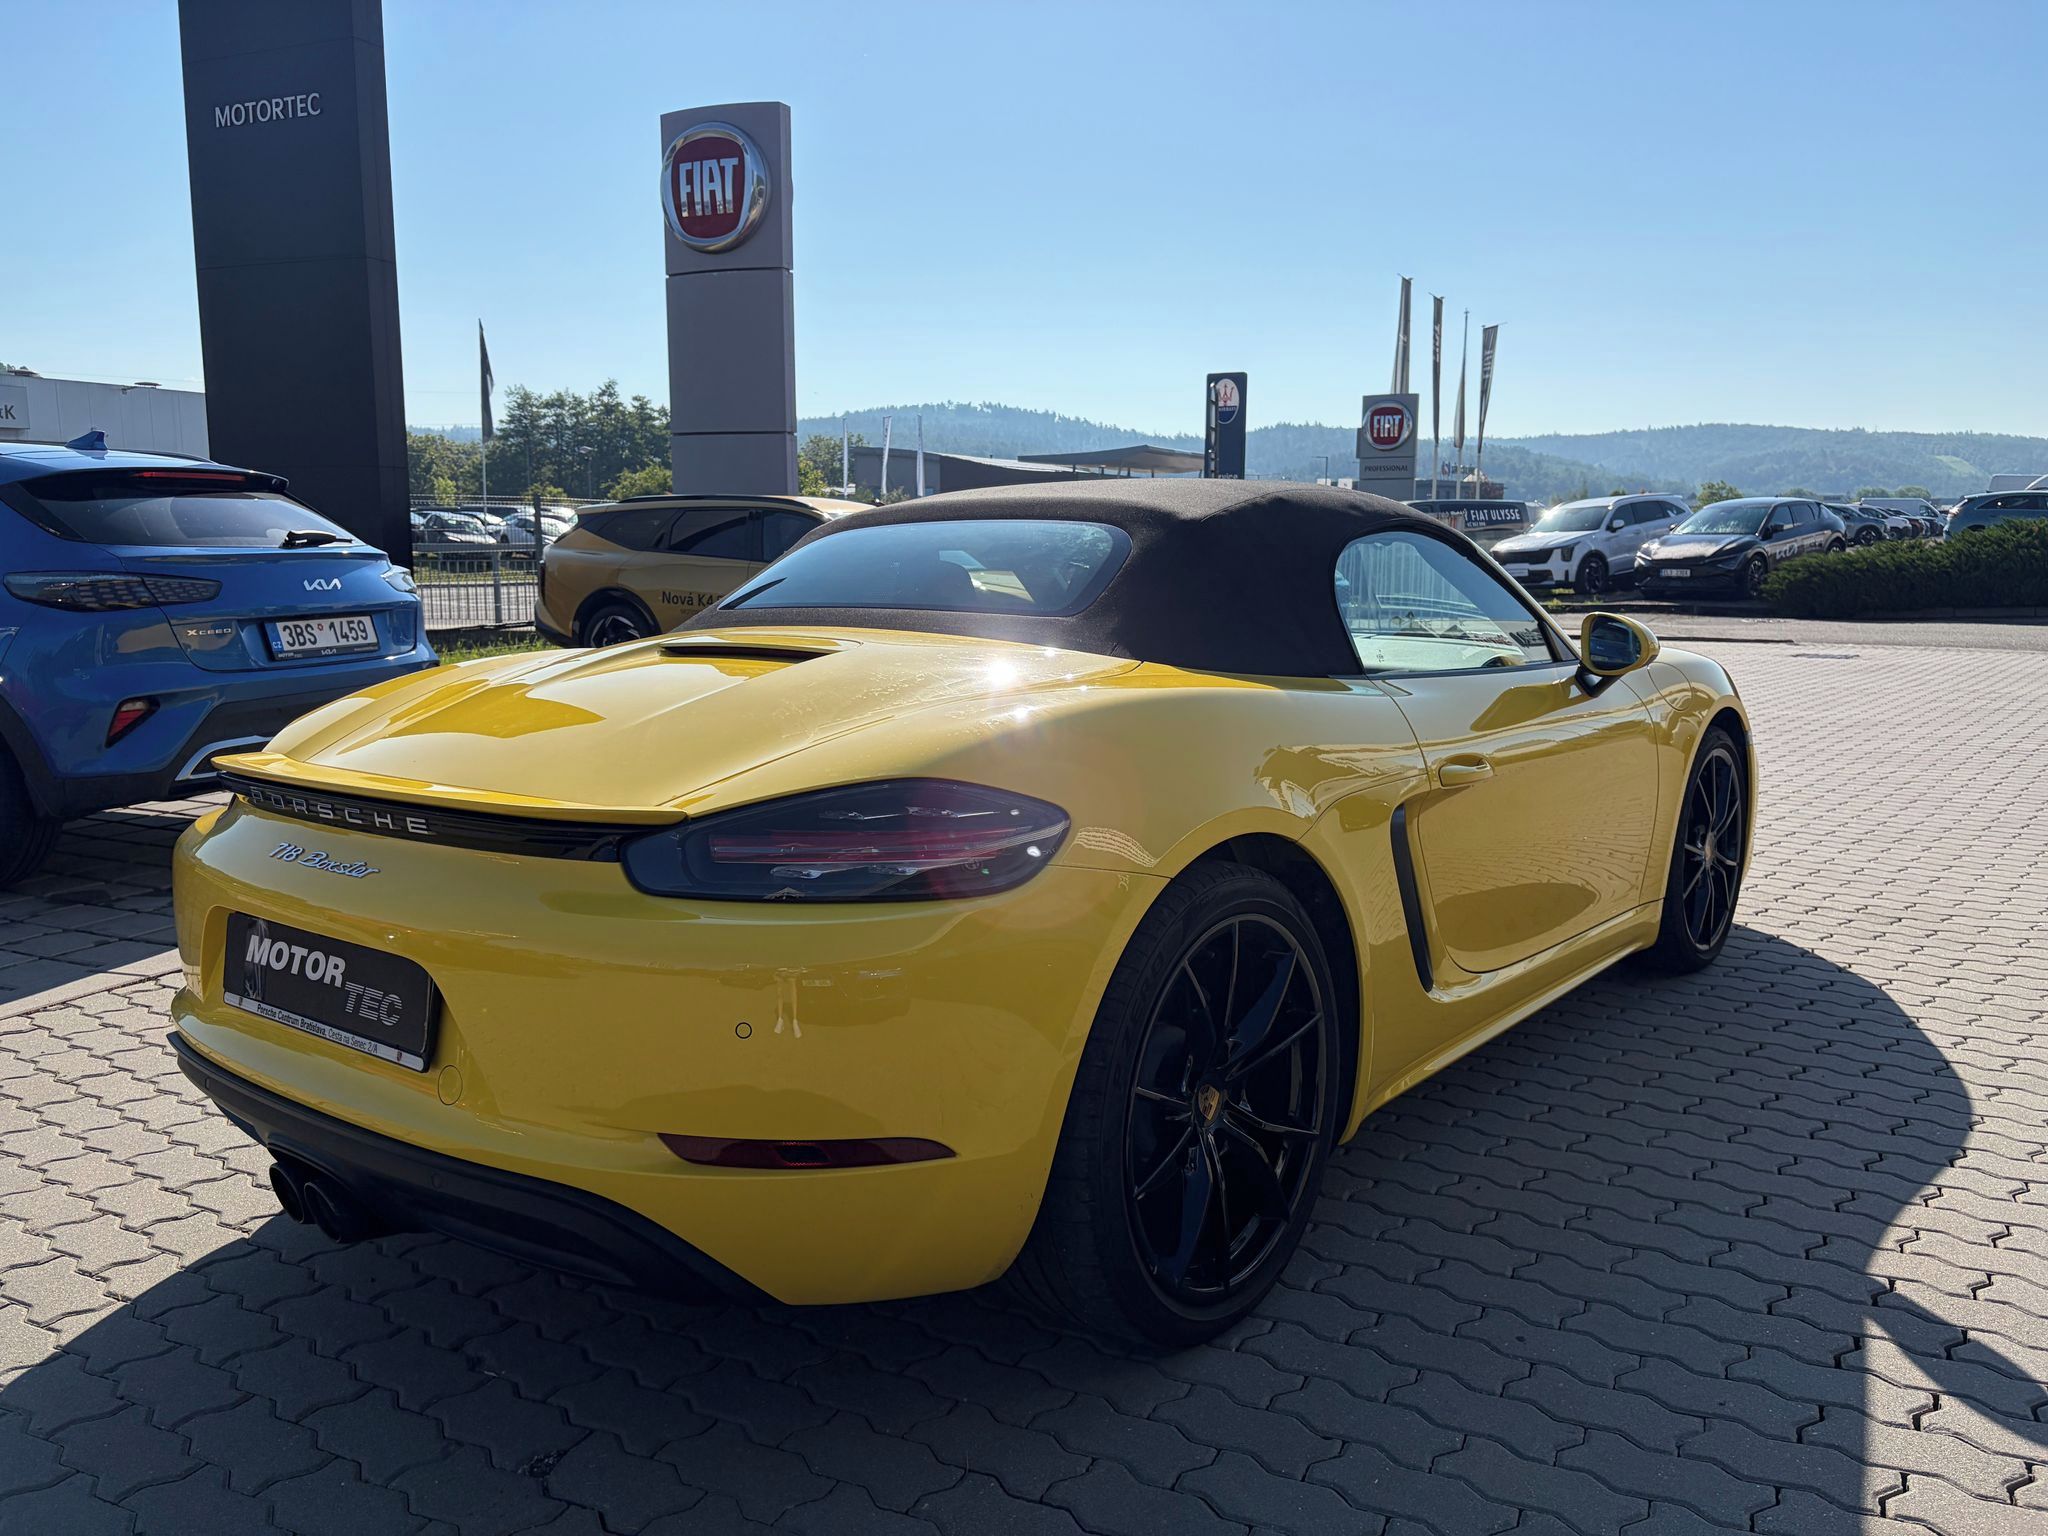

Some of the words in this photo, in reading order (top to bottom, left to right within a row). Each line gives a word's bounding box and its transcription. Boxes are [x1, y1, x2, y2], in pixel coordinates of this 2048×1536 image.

[214, 92, 321, 128] MOTORTEC
[679, 157, 739, 218] FIAT
[1373, 414, 1402, 438] FIAT
[1364, 464, 1408, 472] PROFESSIONAL
[1471, 509, 1489, 521] FIAT
[1490, 508, 1521, 520] ULYSSE
[303, 578, 342, 591] KIA
[662, 591, 694, 606] Nová
[272, 641, 282, 649] CZ
[282, 623, 318, 648] 3BS
[328, 619, 369, 643] 1459
[250, 786, 429, 834] PORSCHE
[269, 842, 303, 862] 718
[299, 851, 380, 878] Boxster
[245, 934, 346, 988] MOTOR
[345, 981, 402, 1026] TEC
[257, 1003, 277, 1018] Porsche
[277, 1010, 299, 1025] Centrum
[328, 1028, 343, 1041] Cesta
[350, 1036, 367, 1050] Senec
